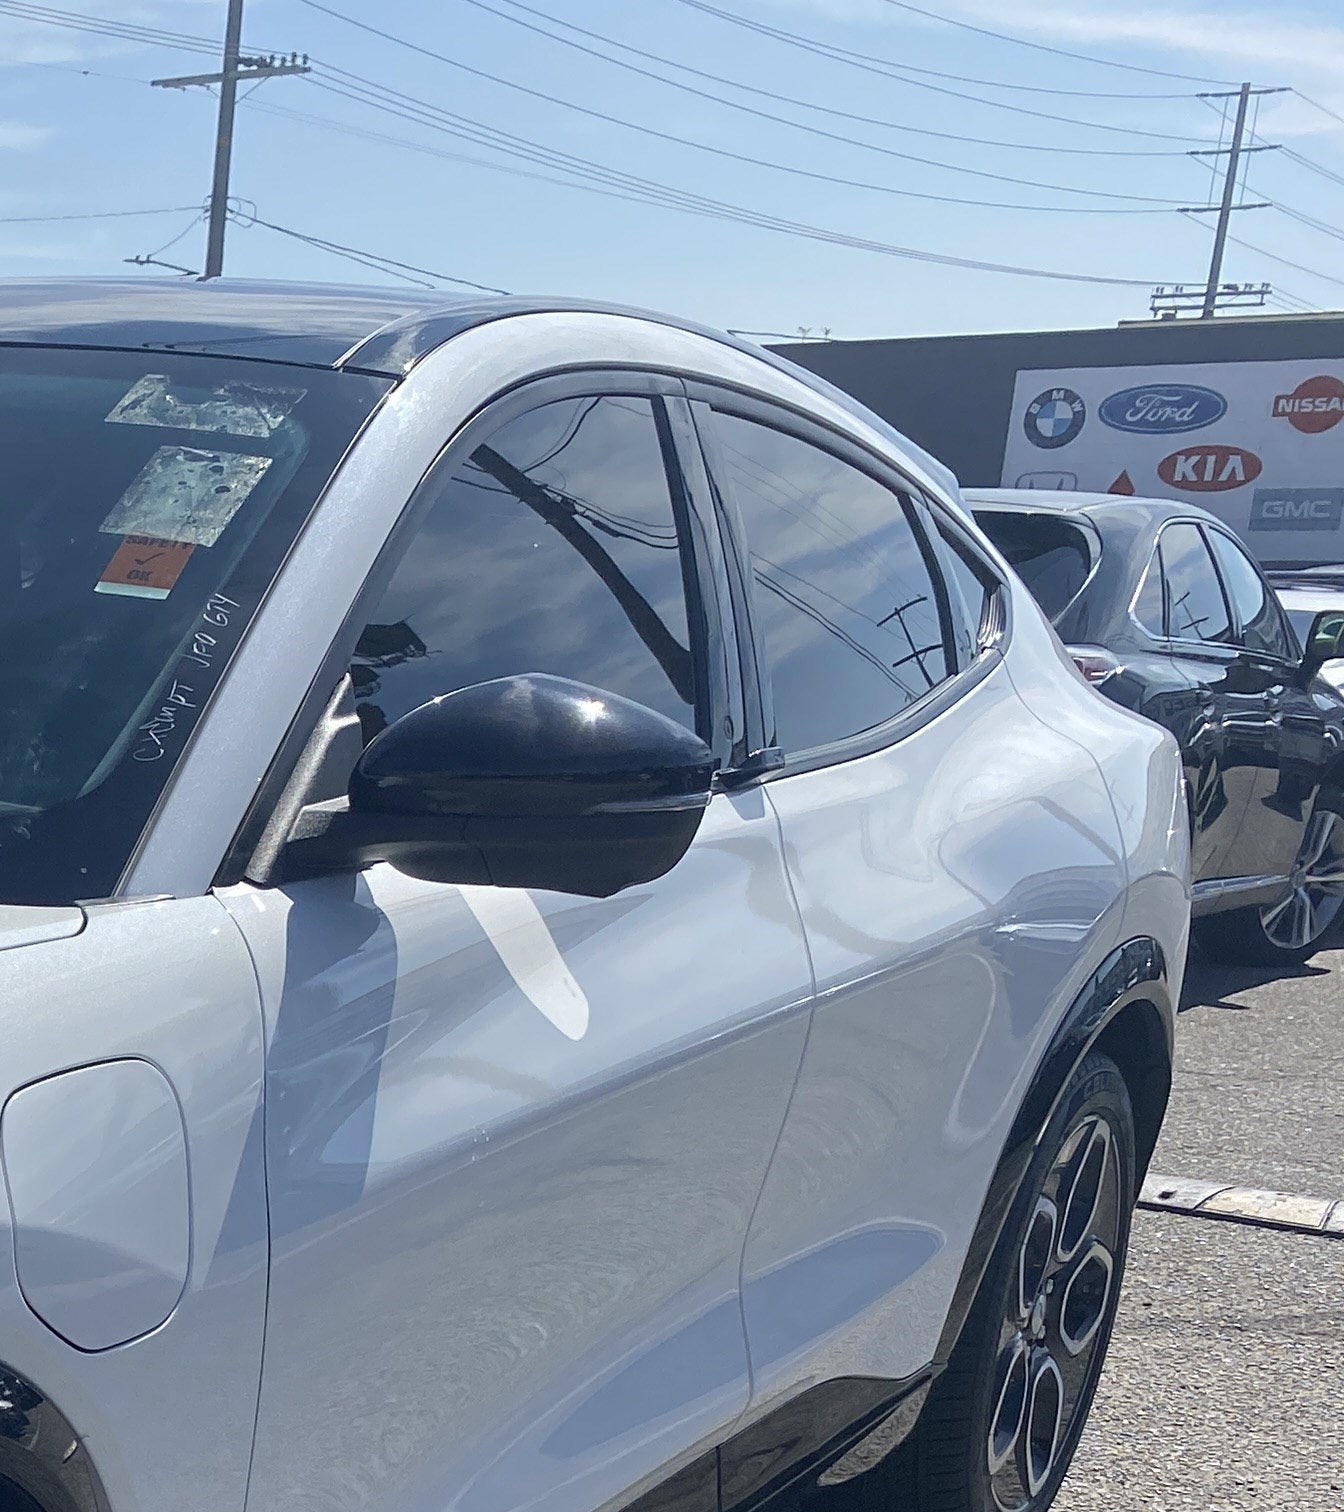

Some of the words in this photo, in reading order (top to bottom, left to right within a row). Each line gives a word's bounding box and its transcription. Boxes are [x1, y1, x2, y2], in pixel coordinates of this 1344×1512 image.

[1028, 389, 1085, 415] BMW
[1125, 395, 1200, 423] Ford
[1277, 397, 1344, 413] NISSA
[1172, 454, 1246, 483] KIA
[1262, 500, 1332, 520] GMC
